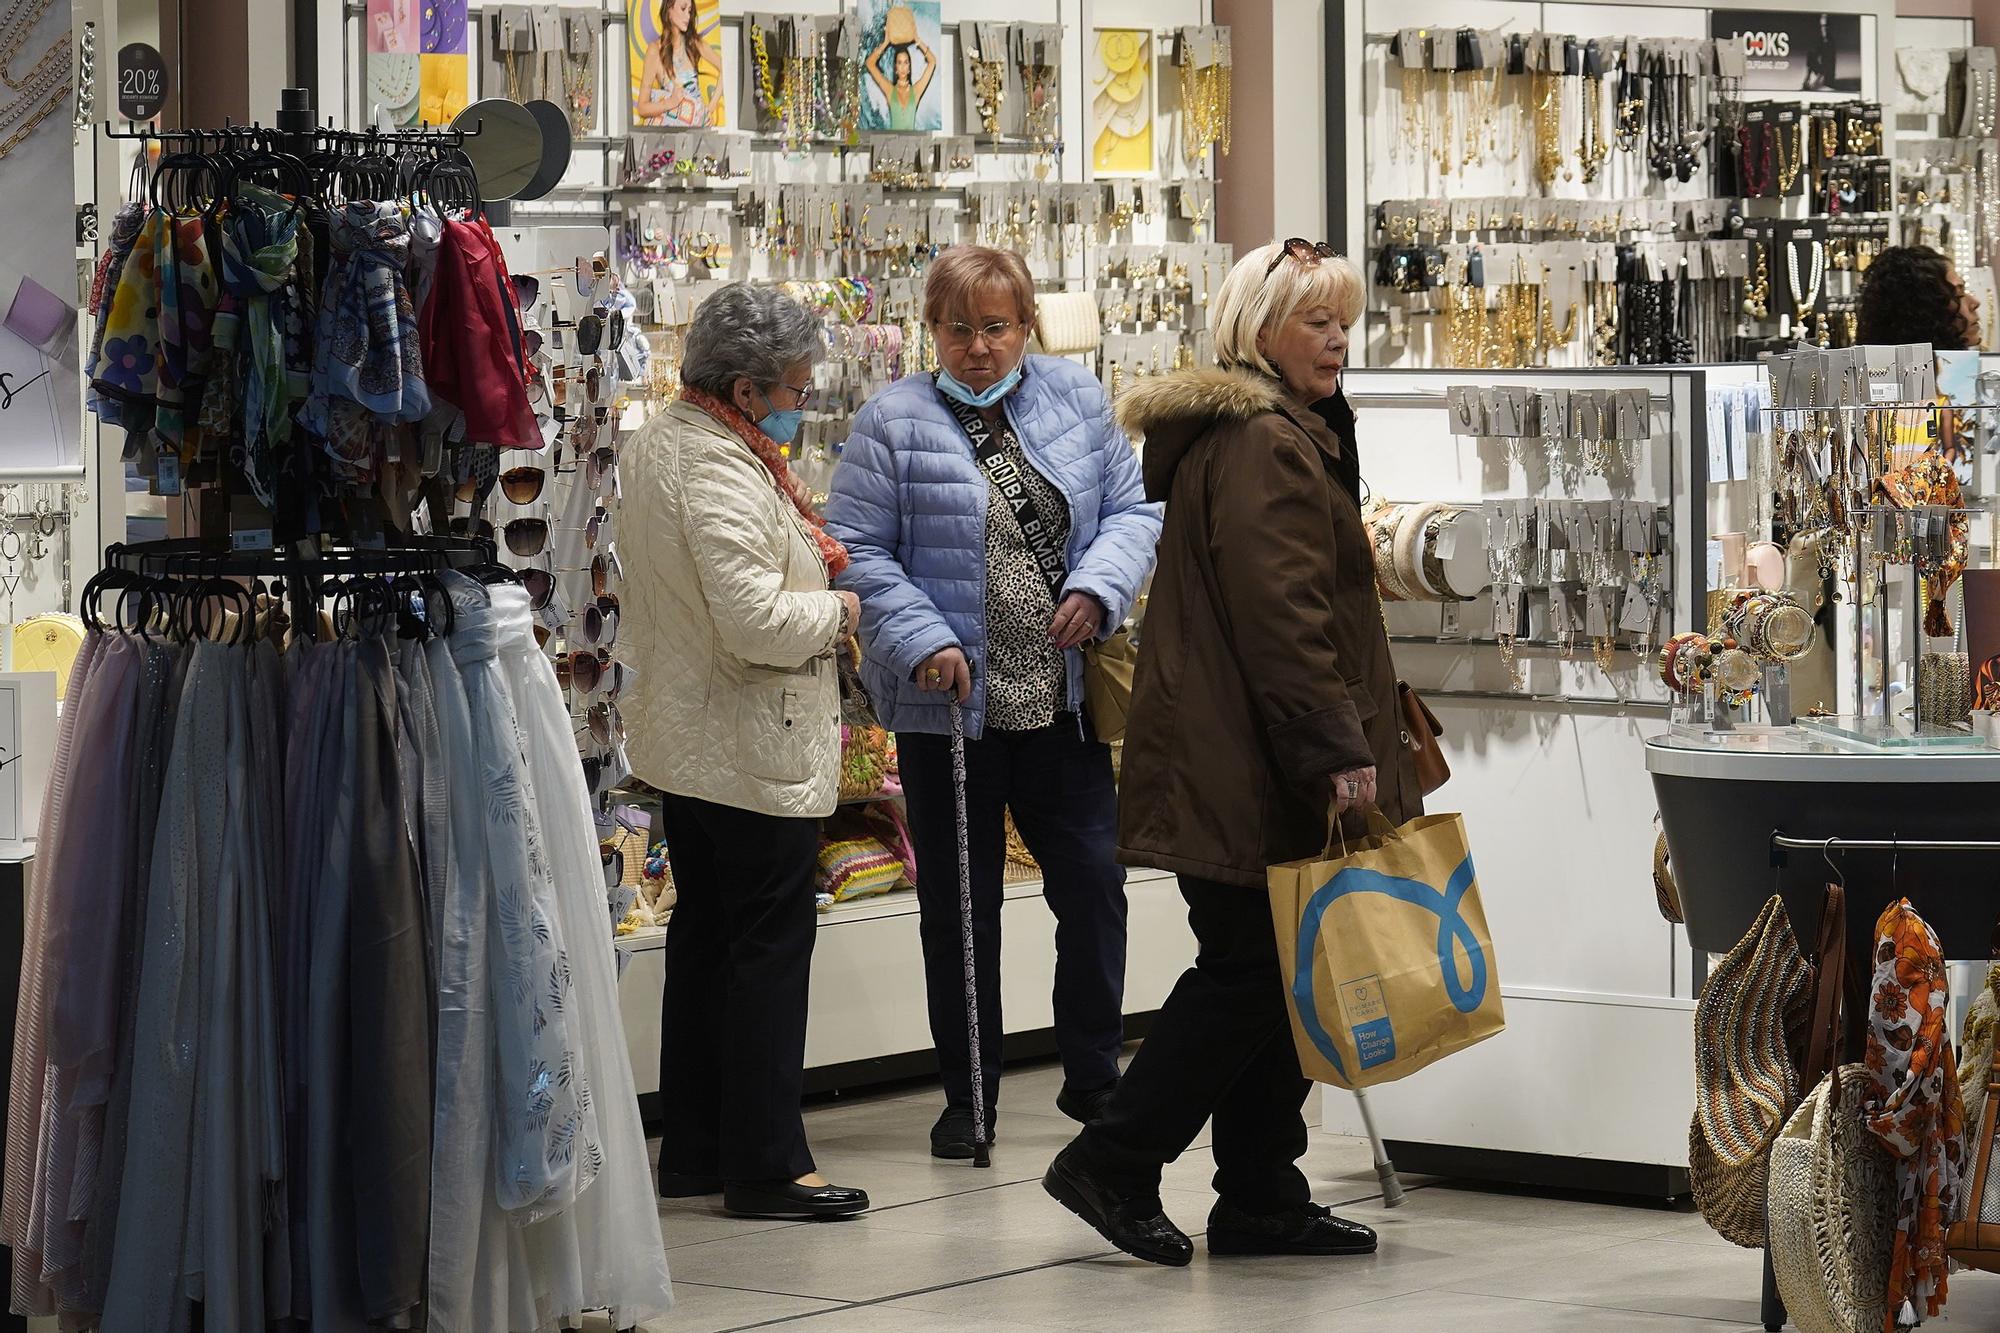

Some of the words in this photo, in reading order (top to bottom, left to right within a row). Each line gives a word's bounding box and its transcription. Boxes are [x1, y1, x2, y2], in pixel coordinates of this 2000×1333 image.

[1733, 31, 1790, 57] OOKS
[118, 69, 160, 94] -20%
[1024, 518, 1064, 585] BIMBA
[1359, 1030, 1377, 1041] How
[1361, 1037, 1391, 1051] Change
[1363, 1048, 1387, 1061] Looks
